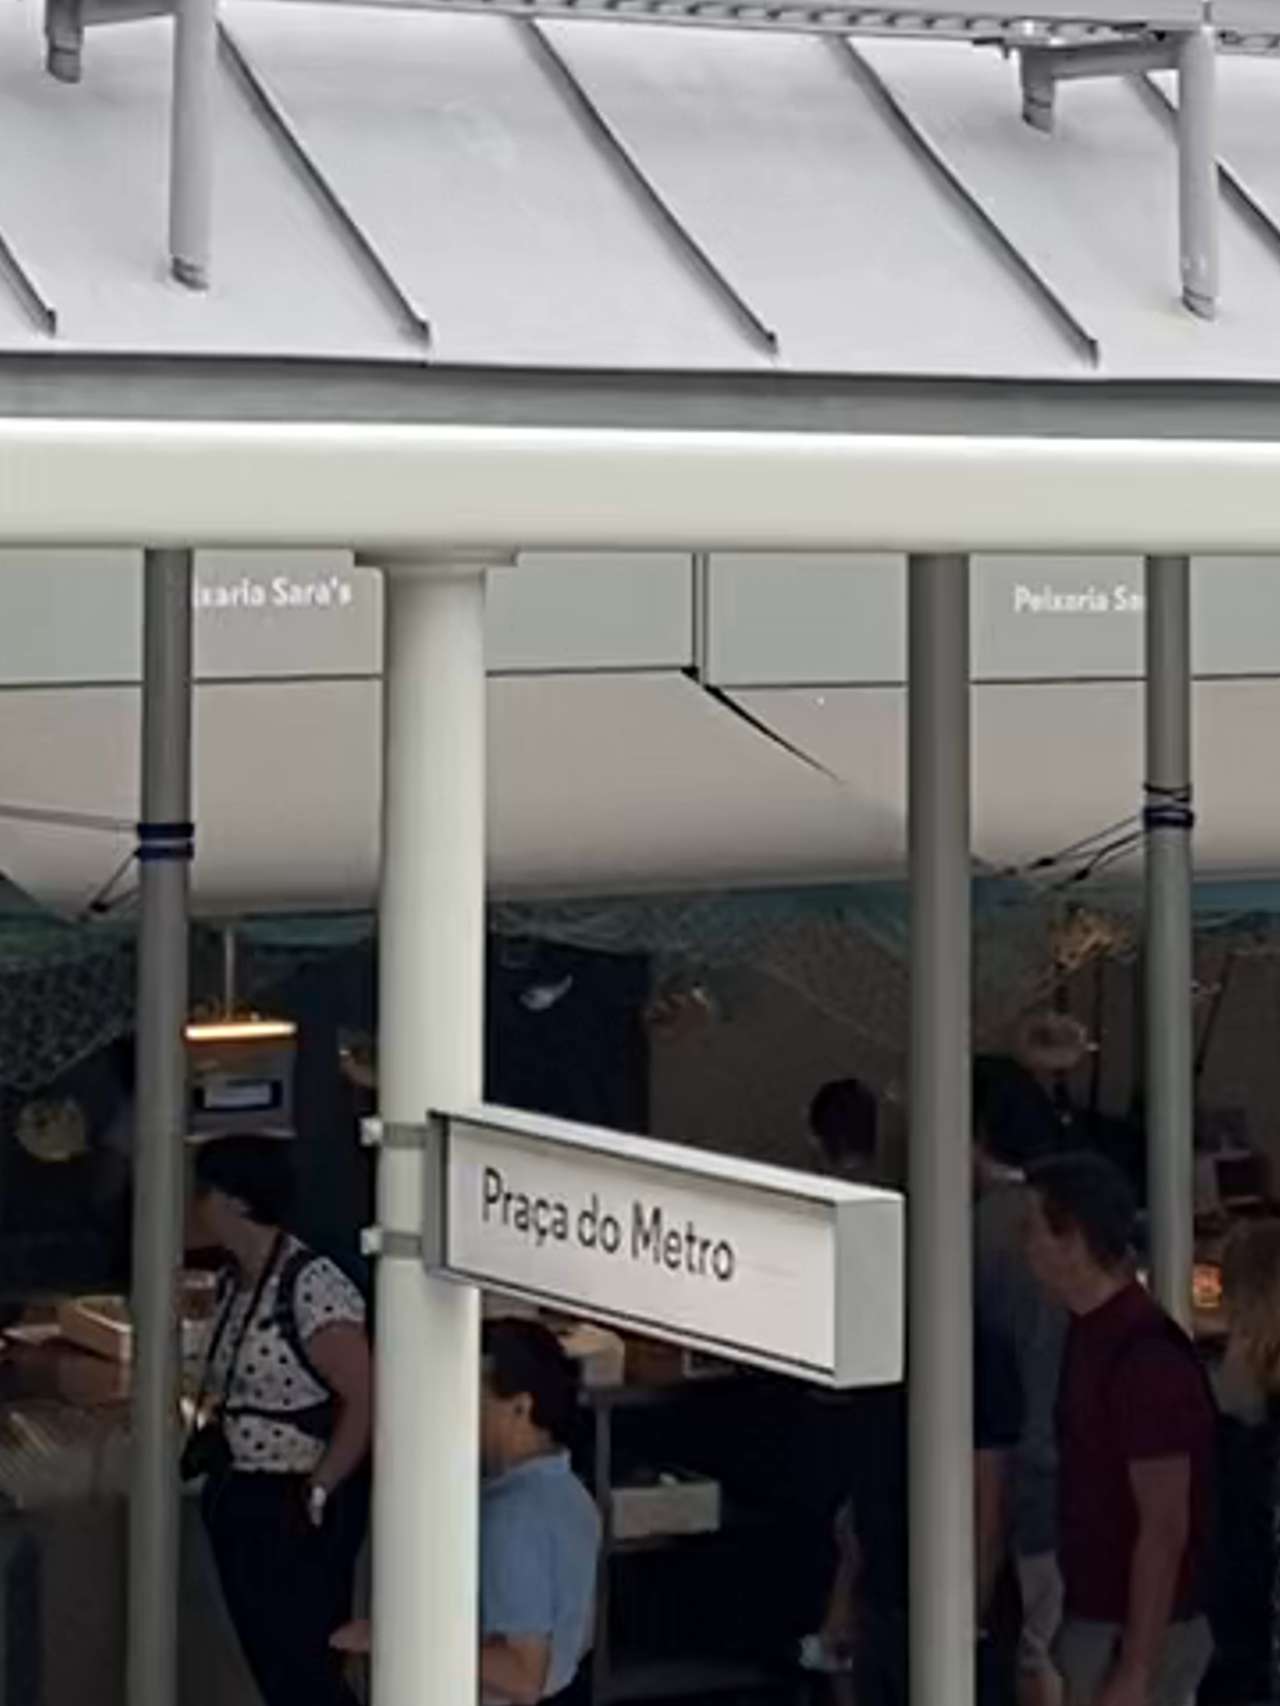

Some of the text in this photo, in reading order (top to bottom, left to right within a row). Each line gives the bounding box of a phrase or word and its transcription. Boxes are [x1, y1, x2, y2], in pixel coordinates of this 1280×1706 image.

[272, 575, 352, 607] Sara's
[482, 1166, 735, 1281] Praça do Metro
